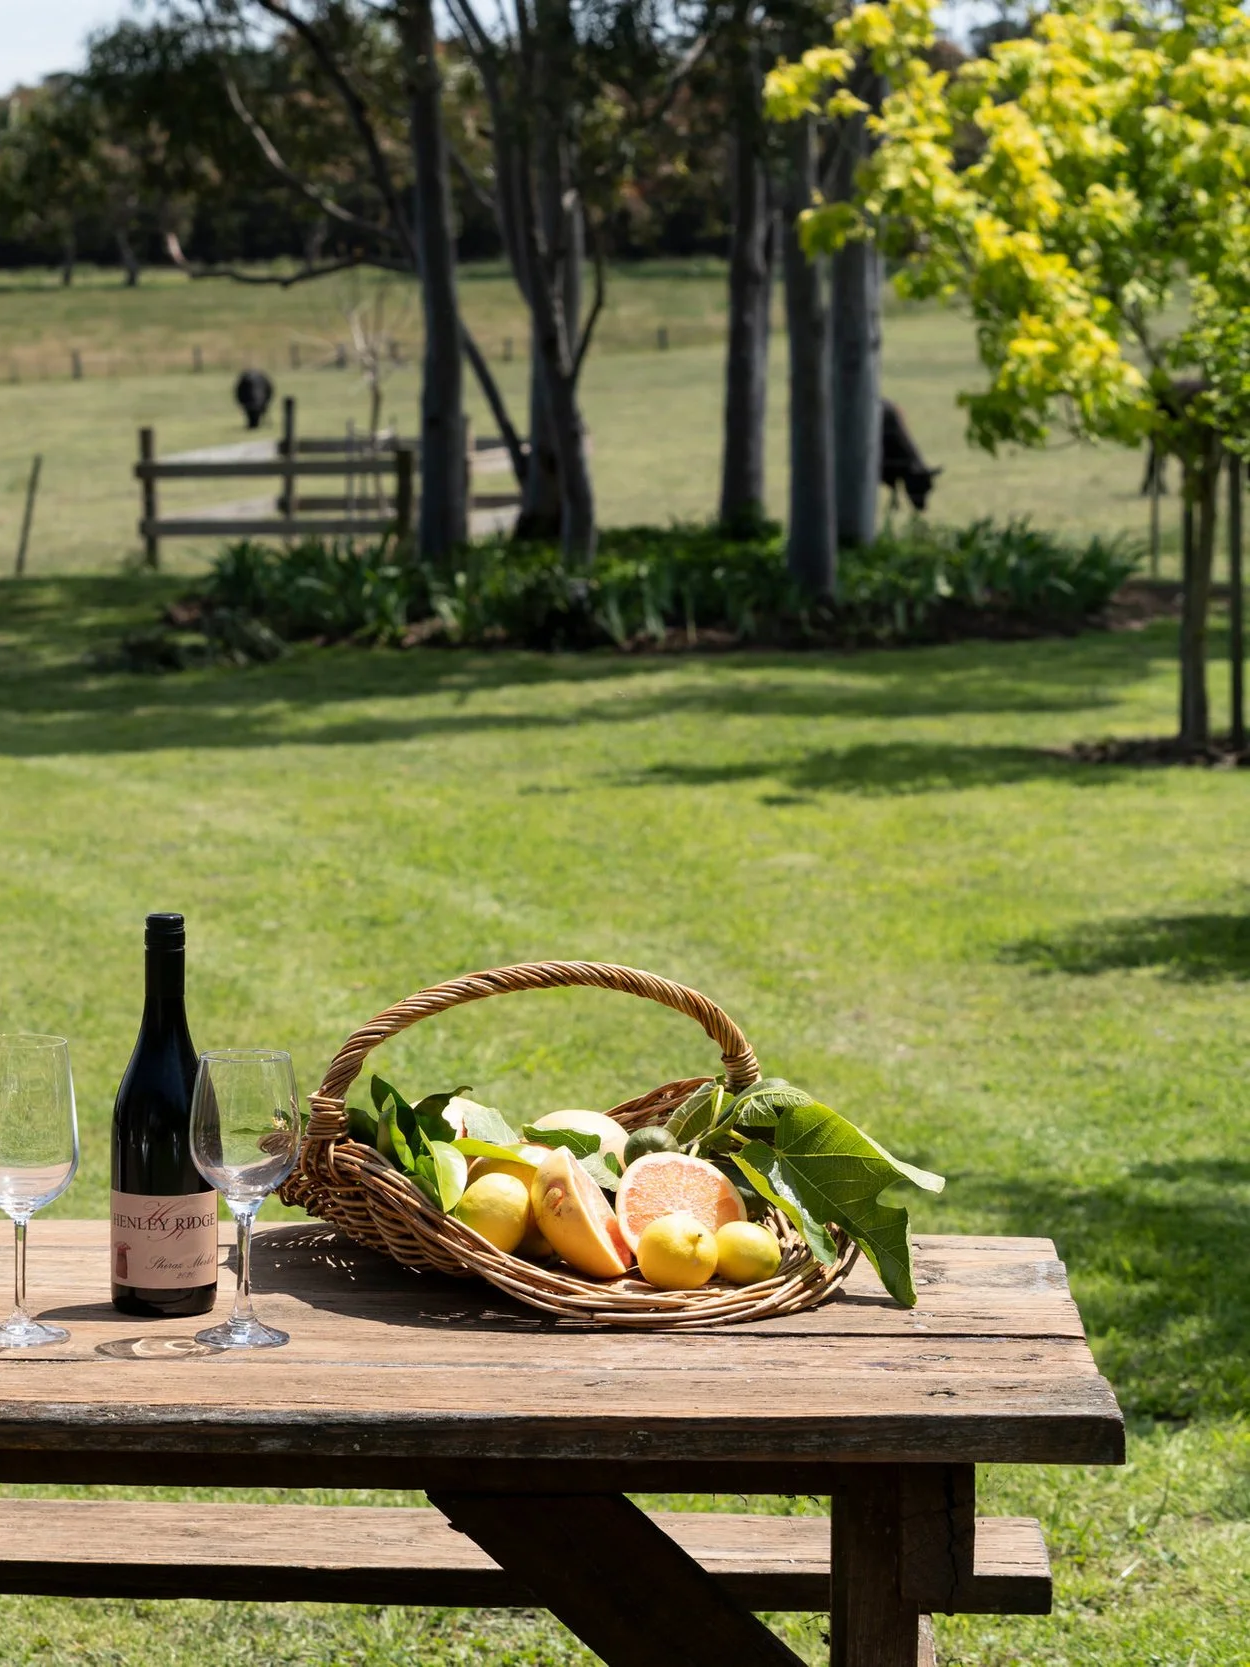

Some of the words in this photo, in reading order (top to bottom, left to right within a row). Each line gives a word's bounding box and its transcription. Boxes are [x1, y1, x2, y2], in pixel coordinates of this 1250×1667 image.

[113, 1212, 170, 1231] HENLEY
[175, 1212, 215, 1230] RIDGE
[145, 1255, 183, 1270] Shiraz
